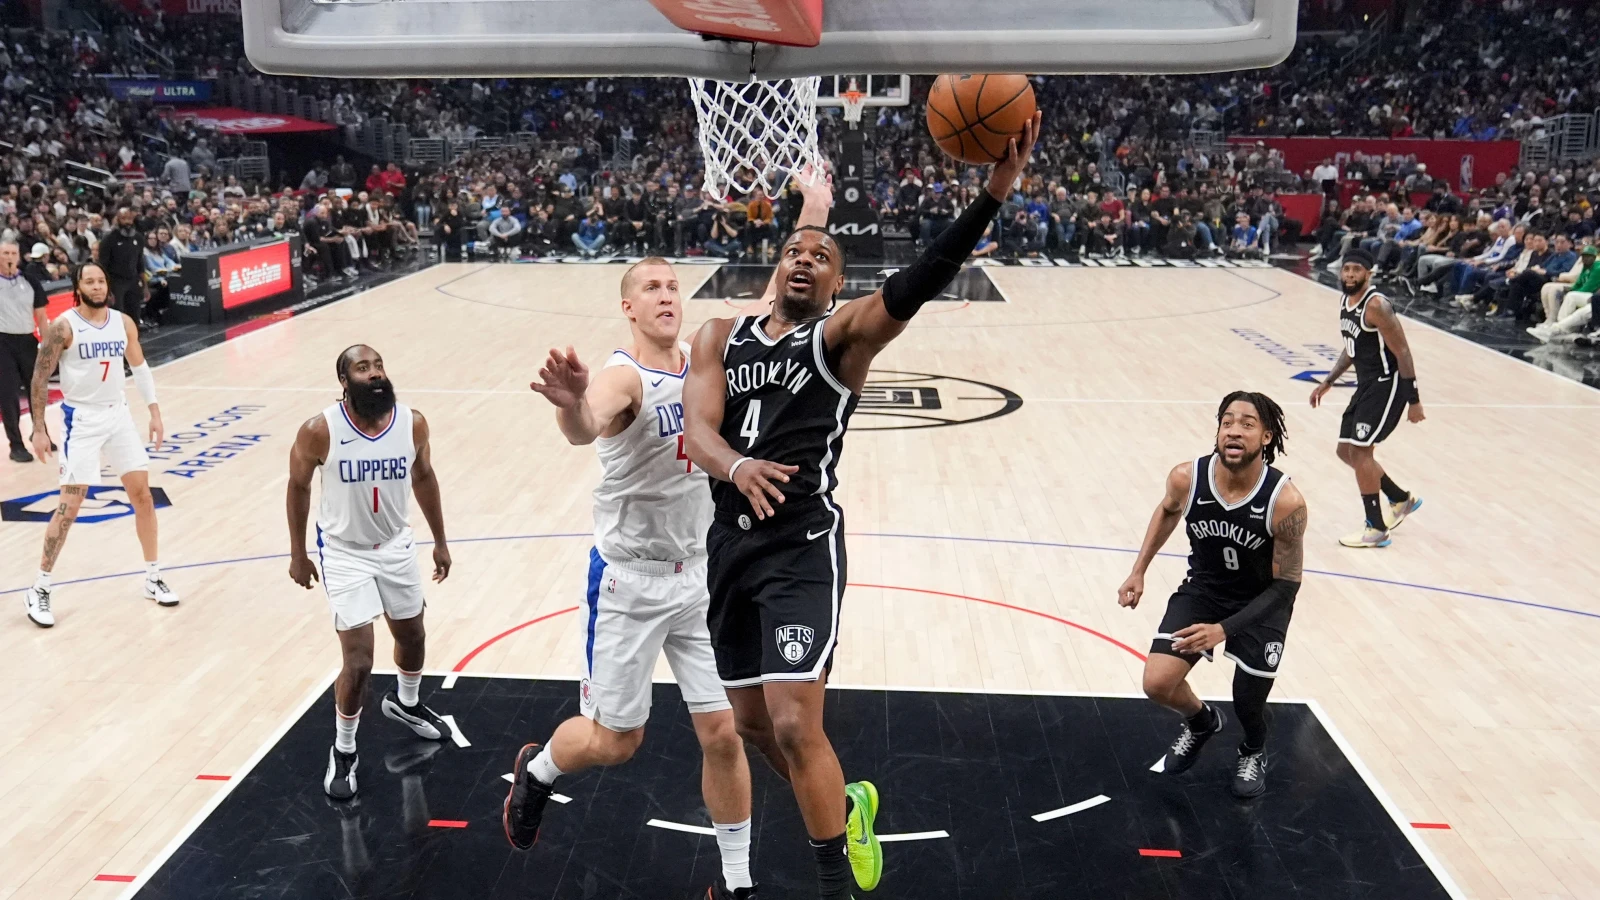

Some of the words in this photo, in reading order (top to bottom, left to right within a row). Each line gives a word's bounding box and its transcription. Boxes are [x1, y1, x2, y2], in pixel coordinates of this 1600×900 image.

[163, 86, 196, 96] ULTRA
[78, 339, 125, 360] CLIPPERS
[99, 361, 110, 382] 7
[726, 357, 813, 398] ROOKLYN
[655, 401, 684, 438] CLIP
[740, 398, 762, 450] 4
[161, 433, 271, 478] ARENA
[339, 456, 407, 483] CLIPPERS
[373, 486, 379, 513] 1
[1189, 519, 1266, 551] BROOKLYN
[1222, 546, 1240, 571] 9
[778, 626, 812, 644] NETS
[790, 644, 798, 659] B
